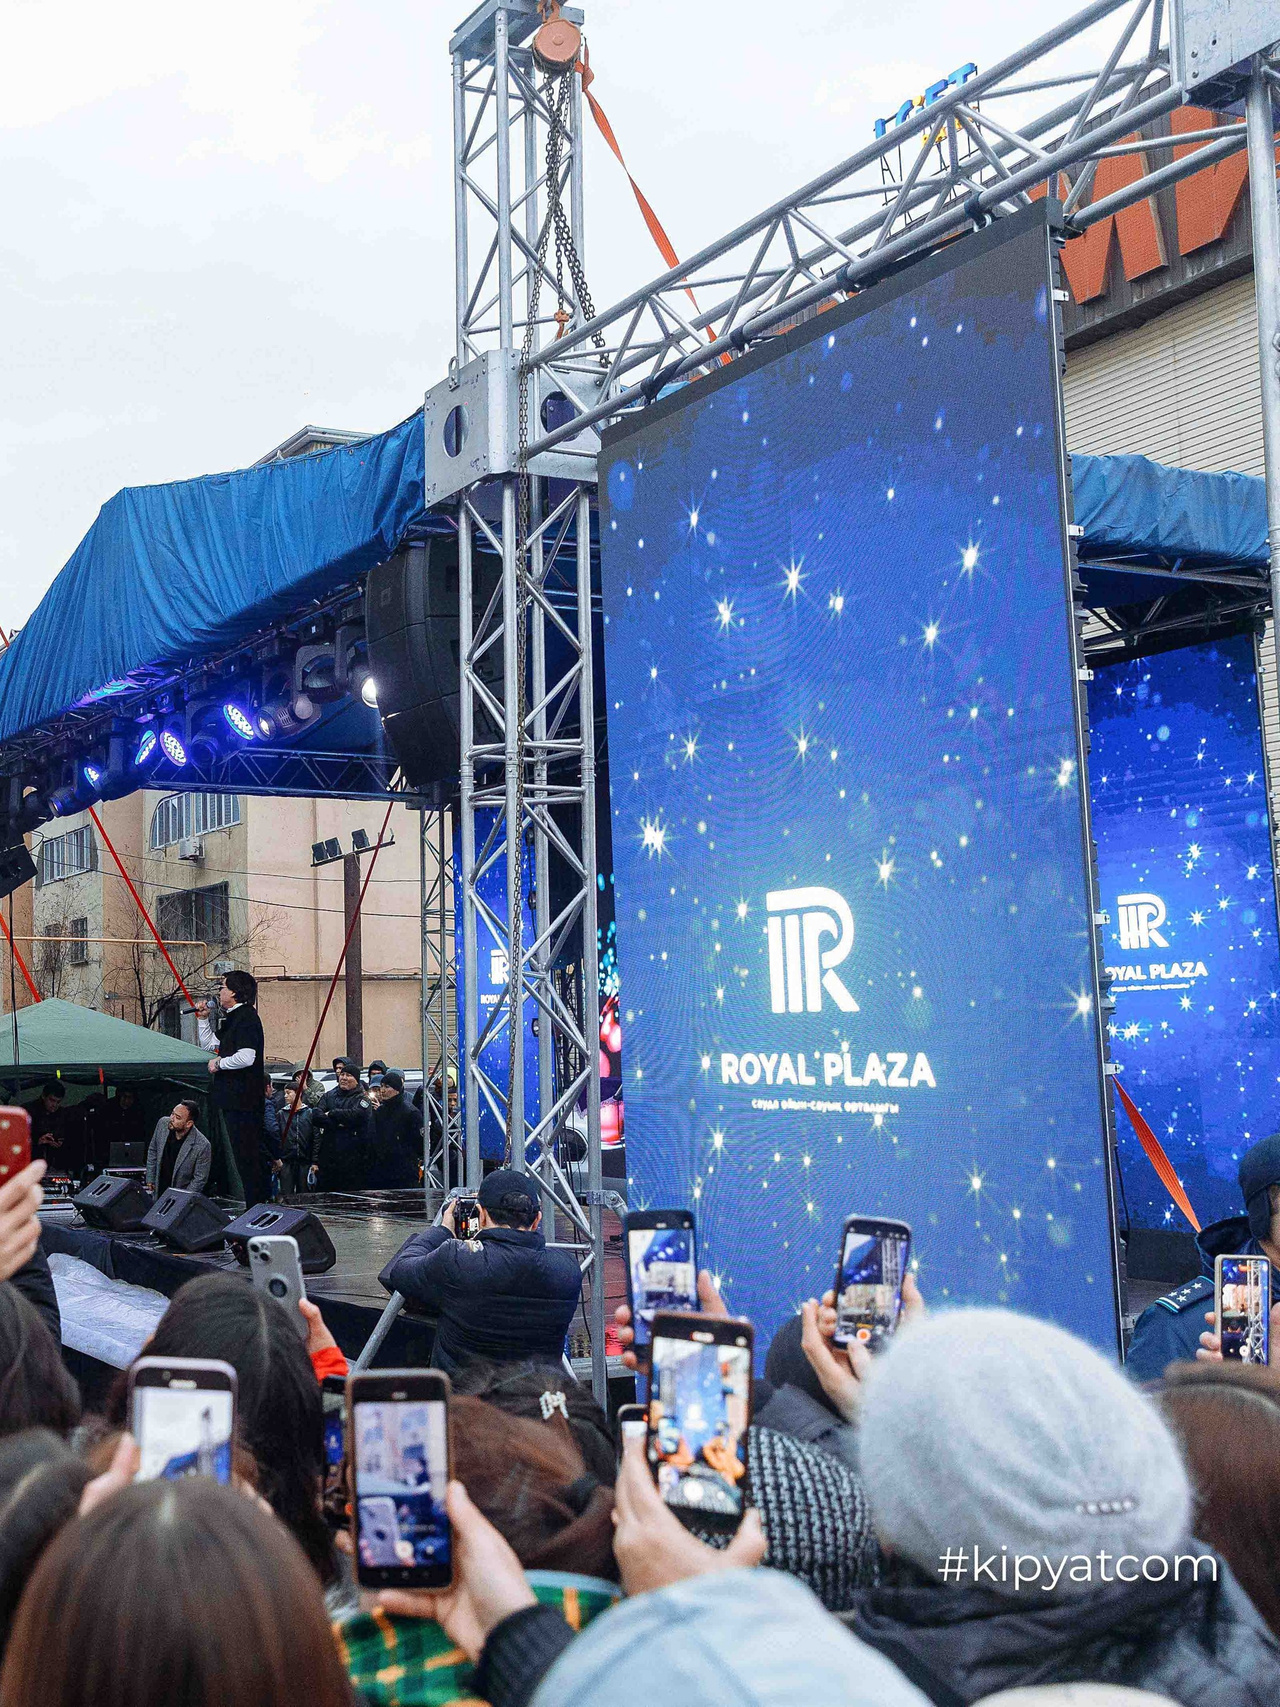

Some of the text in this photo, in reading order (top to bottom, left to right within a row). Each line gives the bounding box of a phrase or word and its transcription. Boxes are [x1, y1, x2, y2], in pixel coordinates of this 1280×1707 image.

[1149, 961, 1209, 980] PLAZA
[721, 1052, 937, 1088] ROYAL PLAZA
